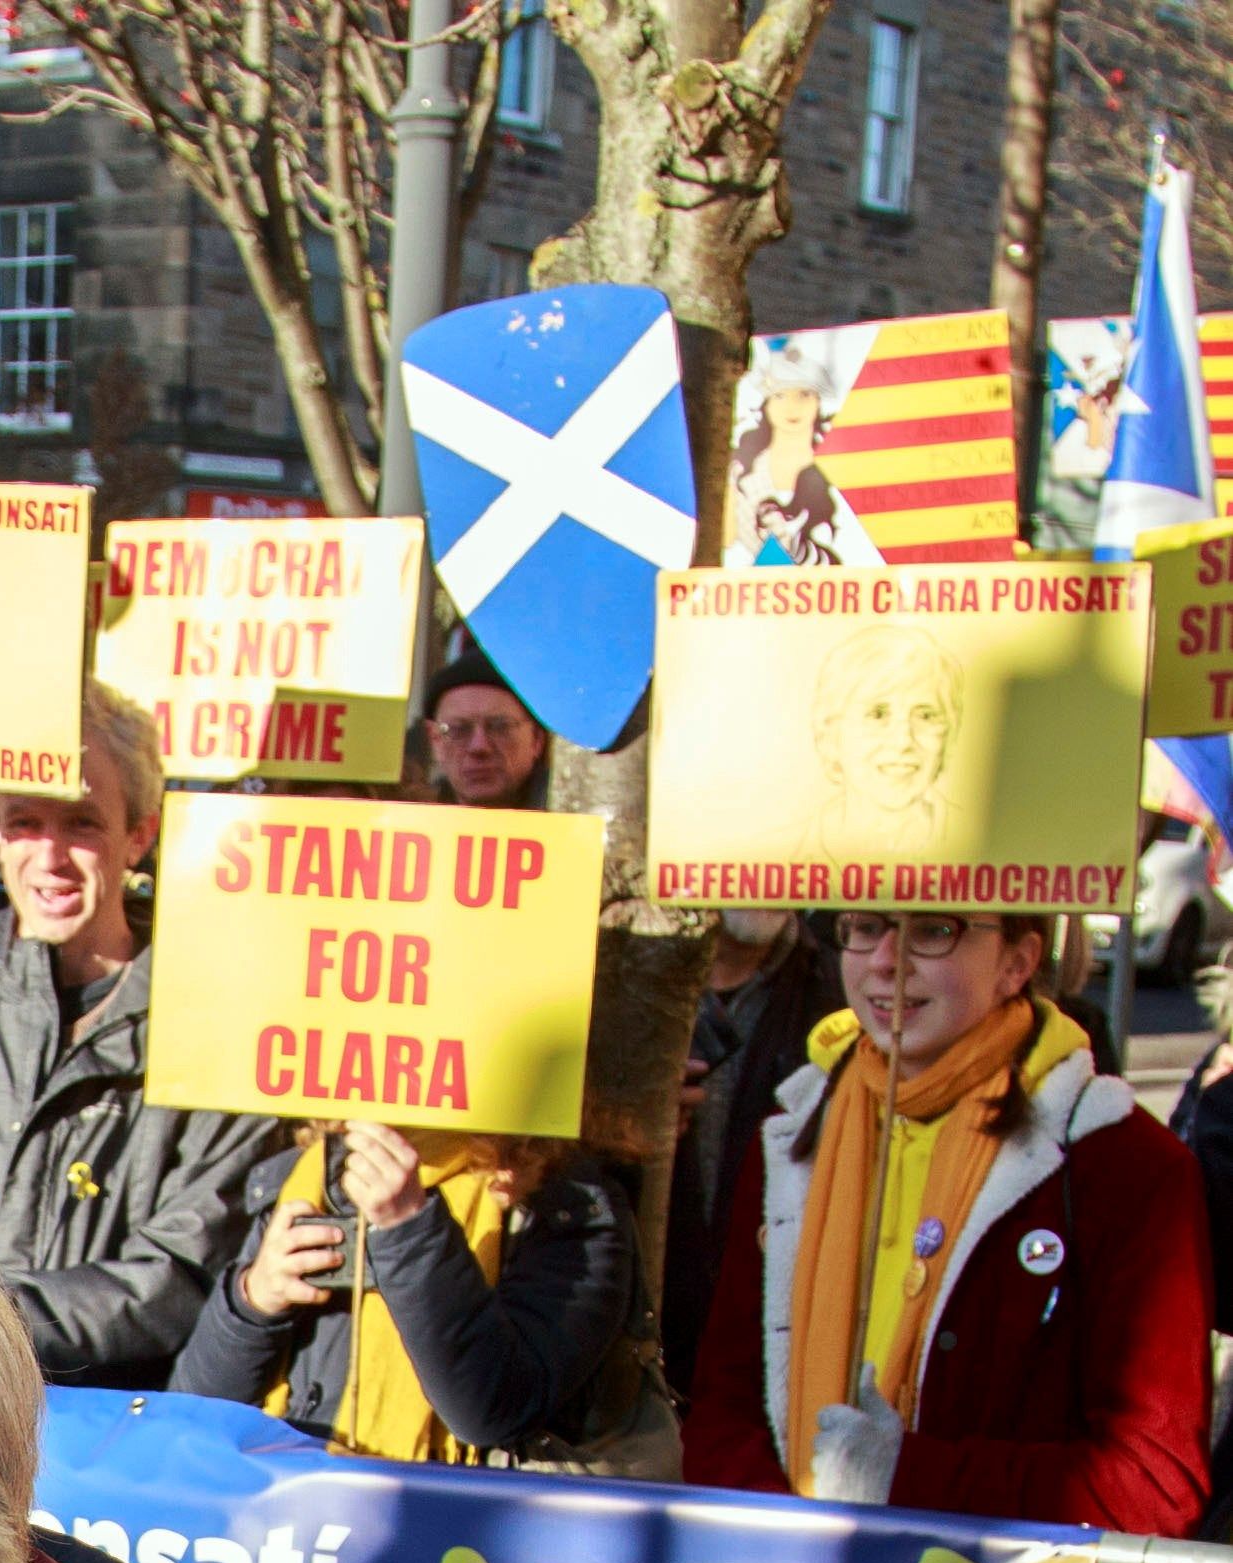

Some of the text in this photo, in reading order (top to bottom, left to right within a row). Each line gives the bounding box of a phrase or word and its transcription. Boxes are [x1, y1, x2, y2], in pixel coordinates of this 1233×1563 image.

[670, 579, 861, 617] PROFESSOR
[872, 577, 980, 615] CLARA
[172, 620, 330, 679] IS NOT
[190, 701, 348, 763] CRIME
[214, 820, 545, 910] STAND UP
[657, 861, 1127, 907] DEFENDER OF DEMOCRACY
[304, 928, 431, 1006] FOR
[254, 1024, 470, 1112] CLARA
